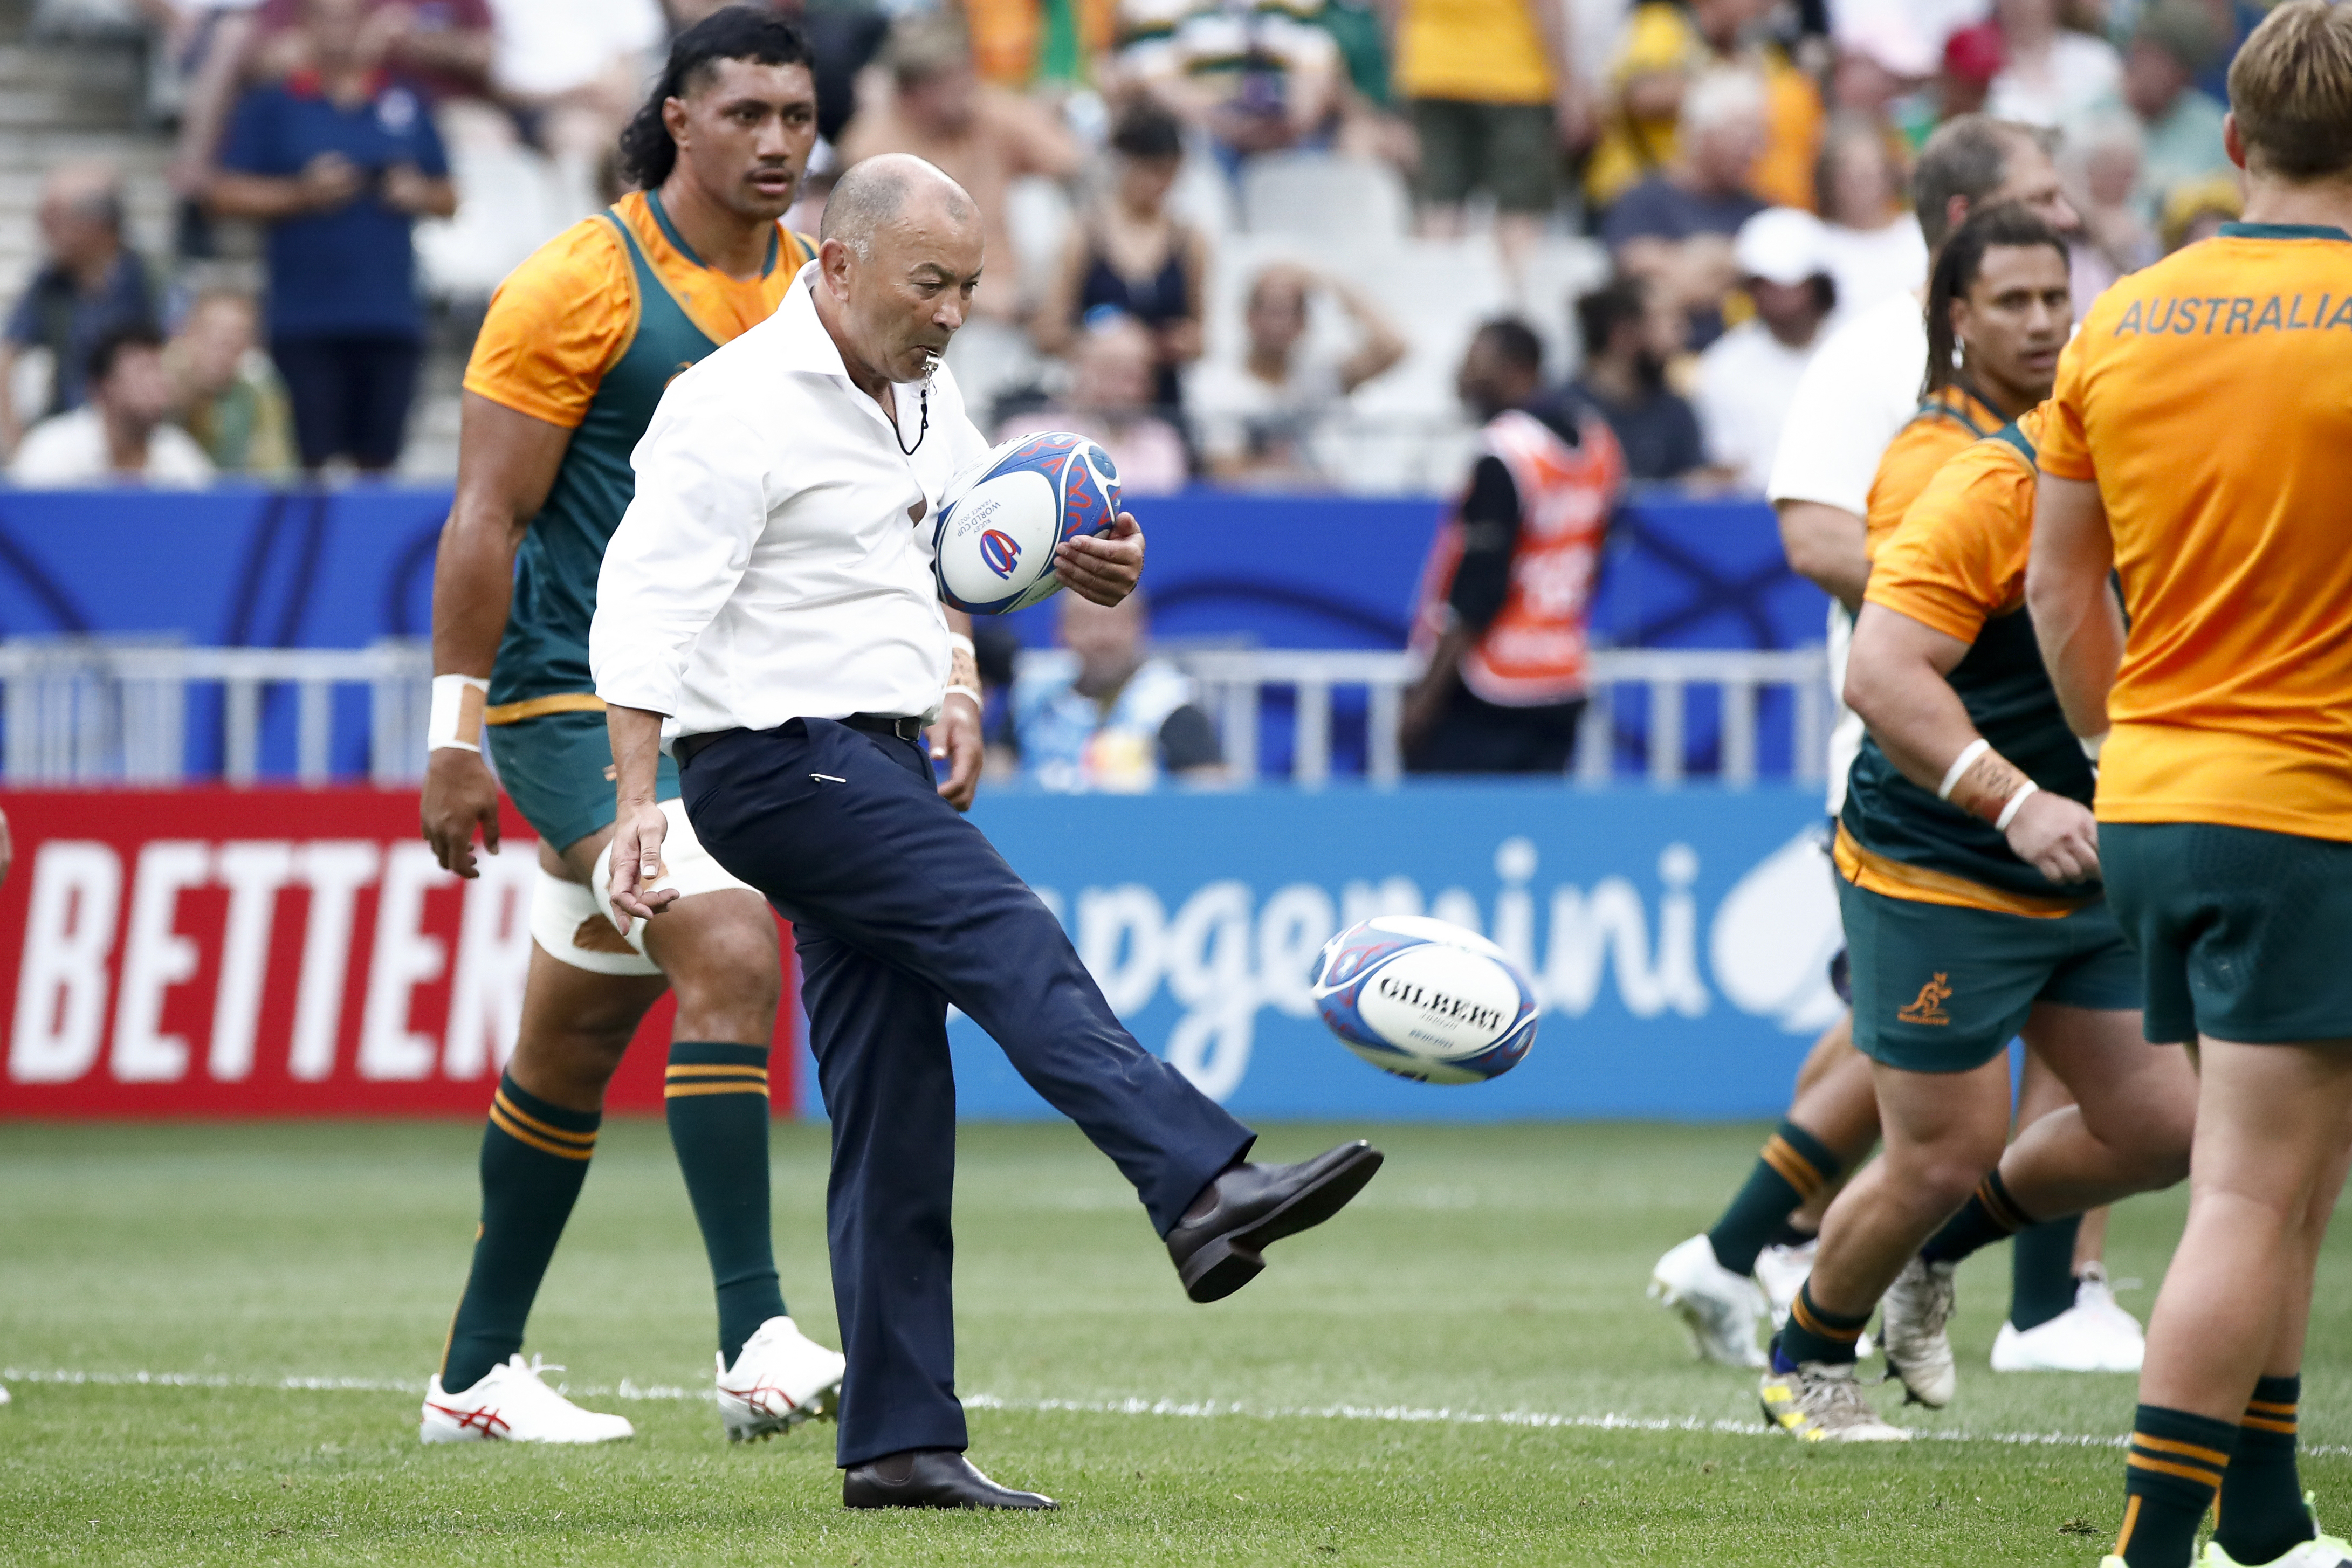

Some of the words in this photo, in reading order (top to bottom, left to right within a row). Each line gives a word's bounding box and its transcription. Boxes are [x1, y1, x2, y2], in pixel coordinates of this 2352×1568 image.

[2114, 293, 2352, 336] AUSTRALIA
[972, 499, 991, 515] FRANCE
[972, 502, 1001, 525] WORLD
[958, 514, 971, 525] 2023
[974, 519, 991, 533] RUGBY
[958, 524, 971, 537] CUP
[6, 840, 539, 1082] BETTER
[1380, 977, 1505, 1032] GILBERT
